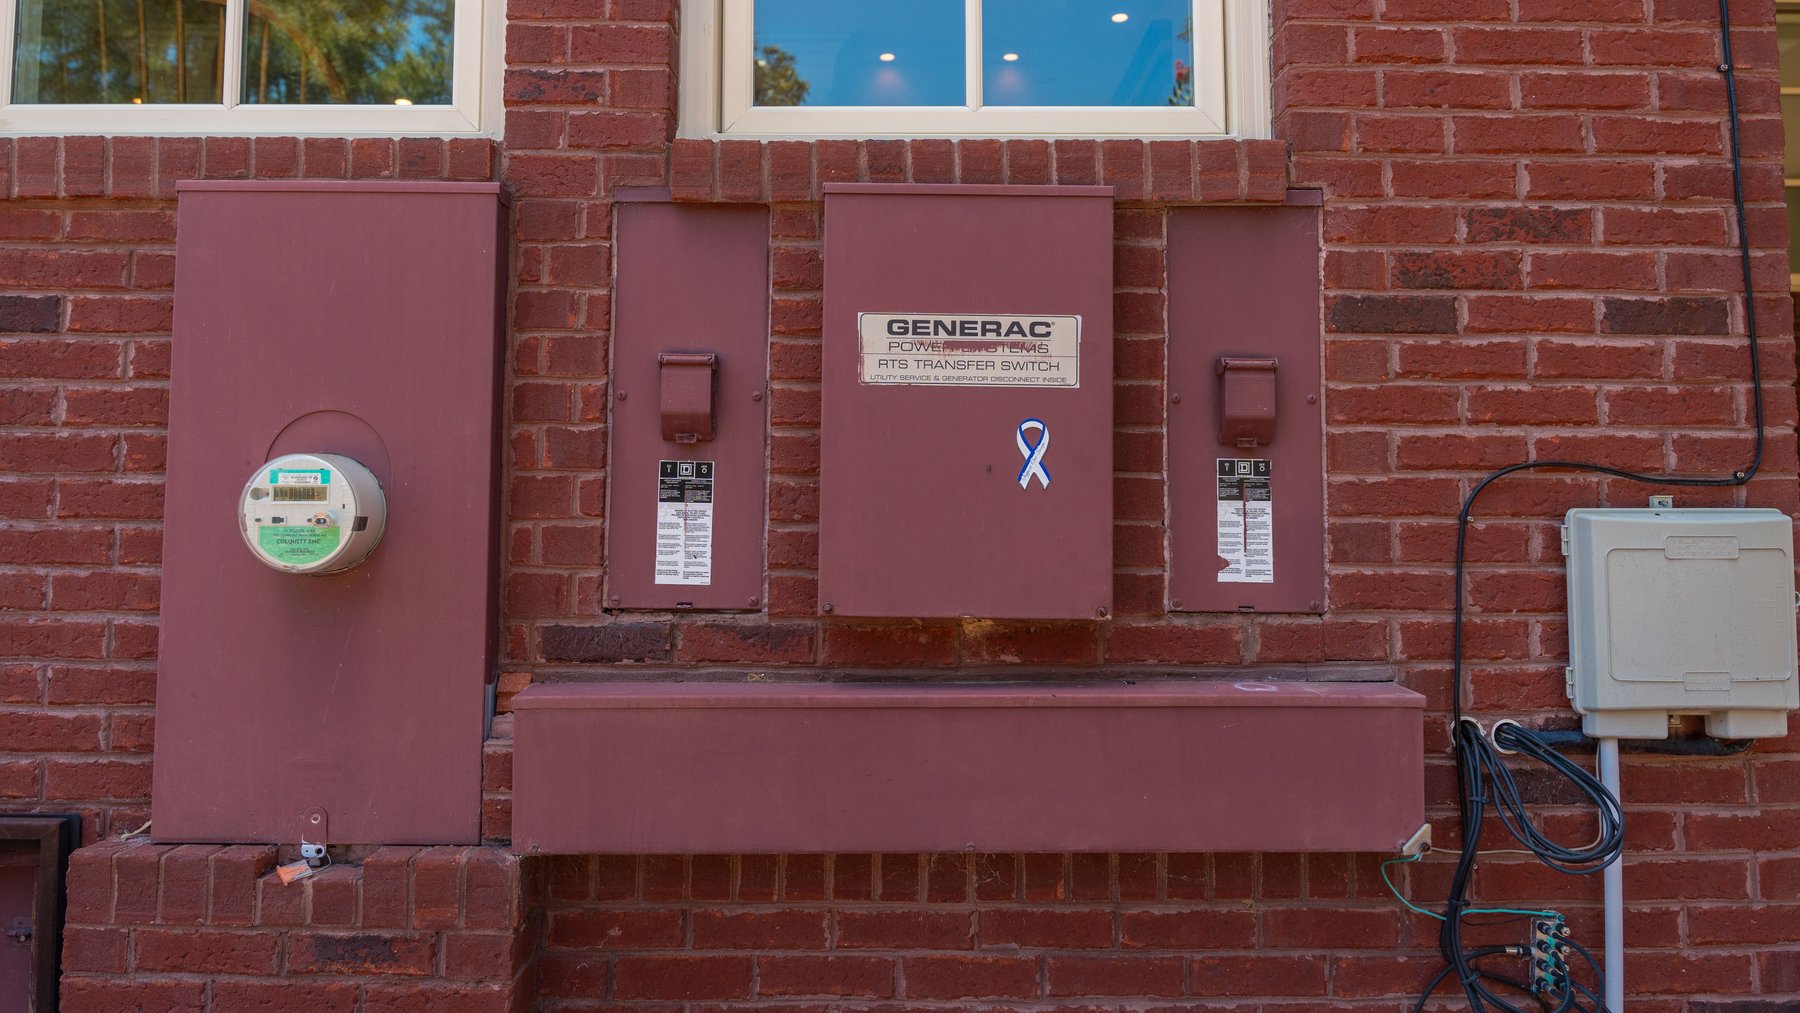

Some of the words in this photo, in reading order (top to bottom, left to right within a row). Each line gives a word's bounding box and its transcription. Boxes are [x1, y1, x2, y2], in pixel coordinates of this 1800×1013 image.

[887, 319, 1052, 338] GENERAC
[878, 359, 908, 370] RTS
[914, 359, 996, 371] TRANSFER
[1001, 360, 1060, 372] SWITCH
[899, 374, 933, 382] SERVICE
